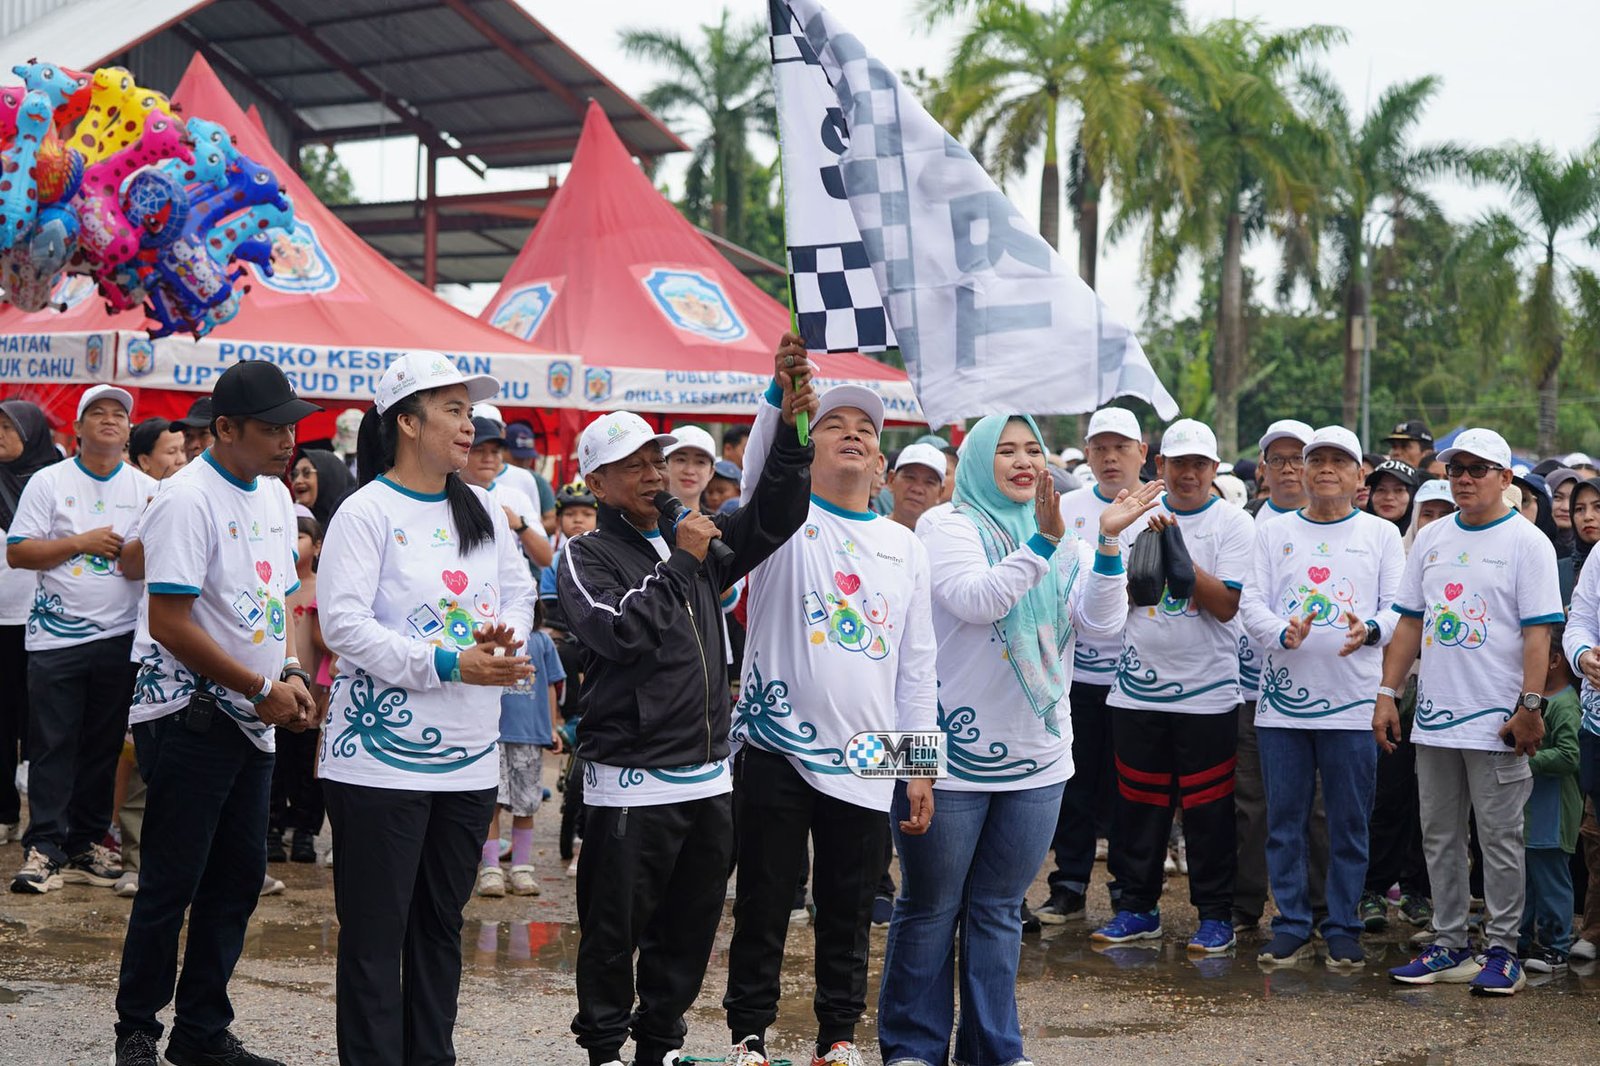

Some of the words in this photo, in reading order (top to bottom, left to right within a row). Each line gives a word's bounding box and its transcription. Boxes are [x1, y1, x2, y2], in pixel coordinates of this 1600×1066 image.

[218, 343, 316, 367] POSKO
[27, 358, 74, 377] CAHU
[666, 371, 722, 385] PUBLIC
[680, 390, 765, 405] KESEHATA
